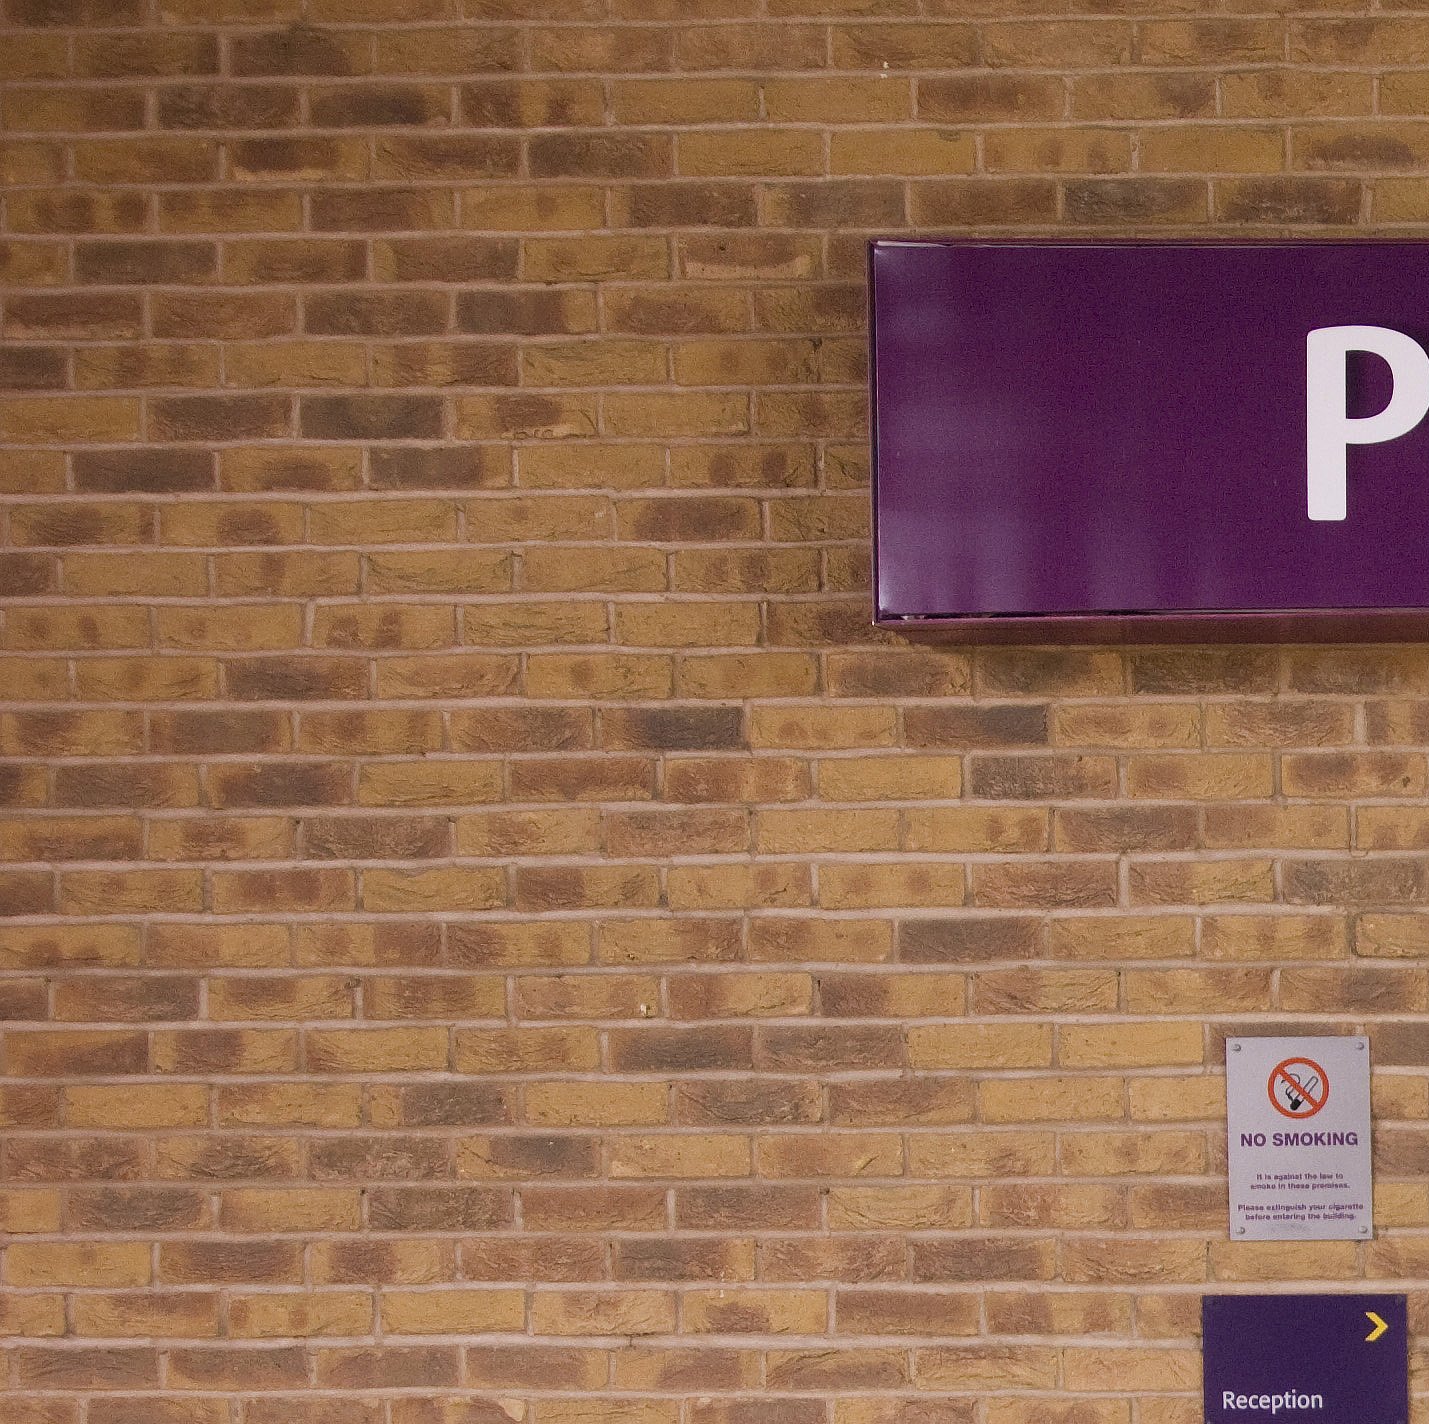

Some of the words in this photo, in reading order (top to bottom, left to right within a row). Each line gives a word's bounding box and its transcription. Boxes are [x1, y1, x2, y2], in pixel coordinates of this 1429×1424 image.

[1240, 1132, 1267, 1147] NO
[1272, 1131, 1358, 1147] SMOKING
[1274, 1173, 1302, 1181] against
[1320, 1172, 1333, 1180] law
[1288, 1182, 1310, 1190] these
[1266, 1204, 1306, 1212] extinguish
[1329, 1203, 1364, 1211] cigarette
[1222, 1388, 1324, 1415] Reception
